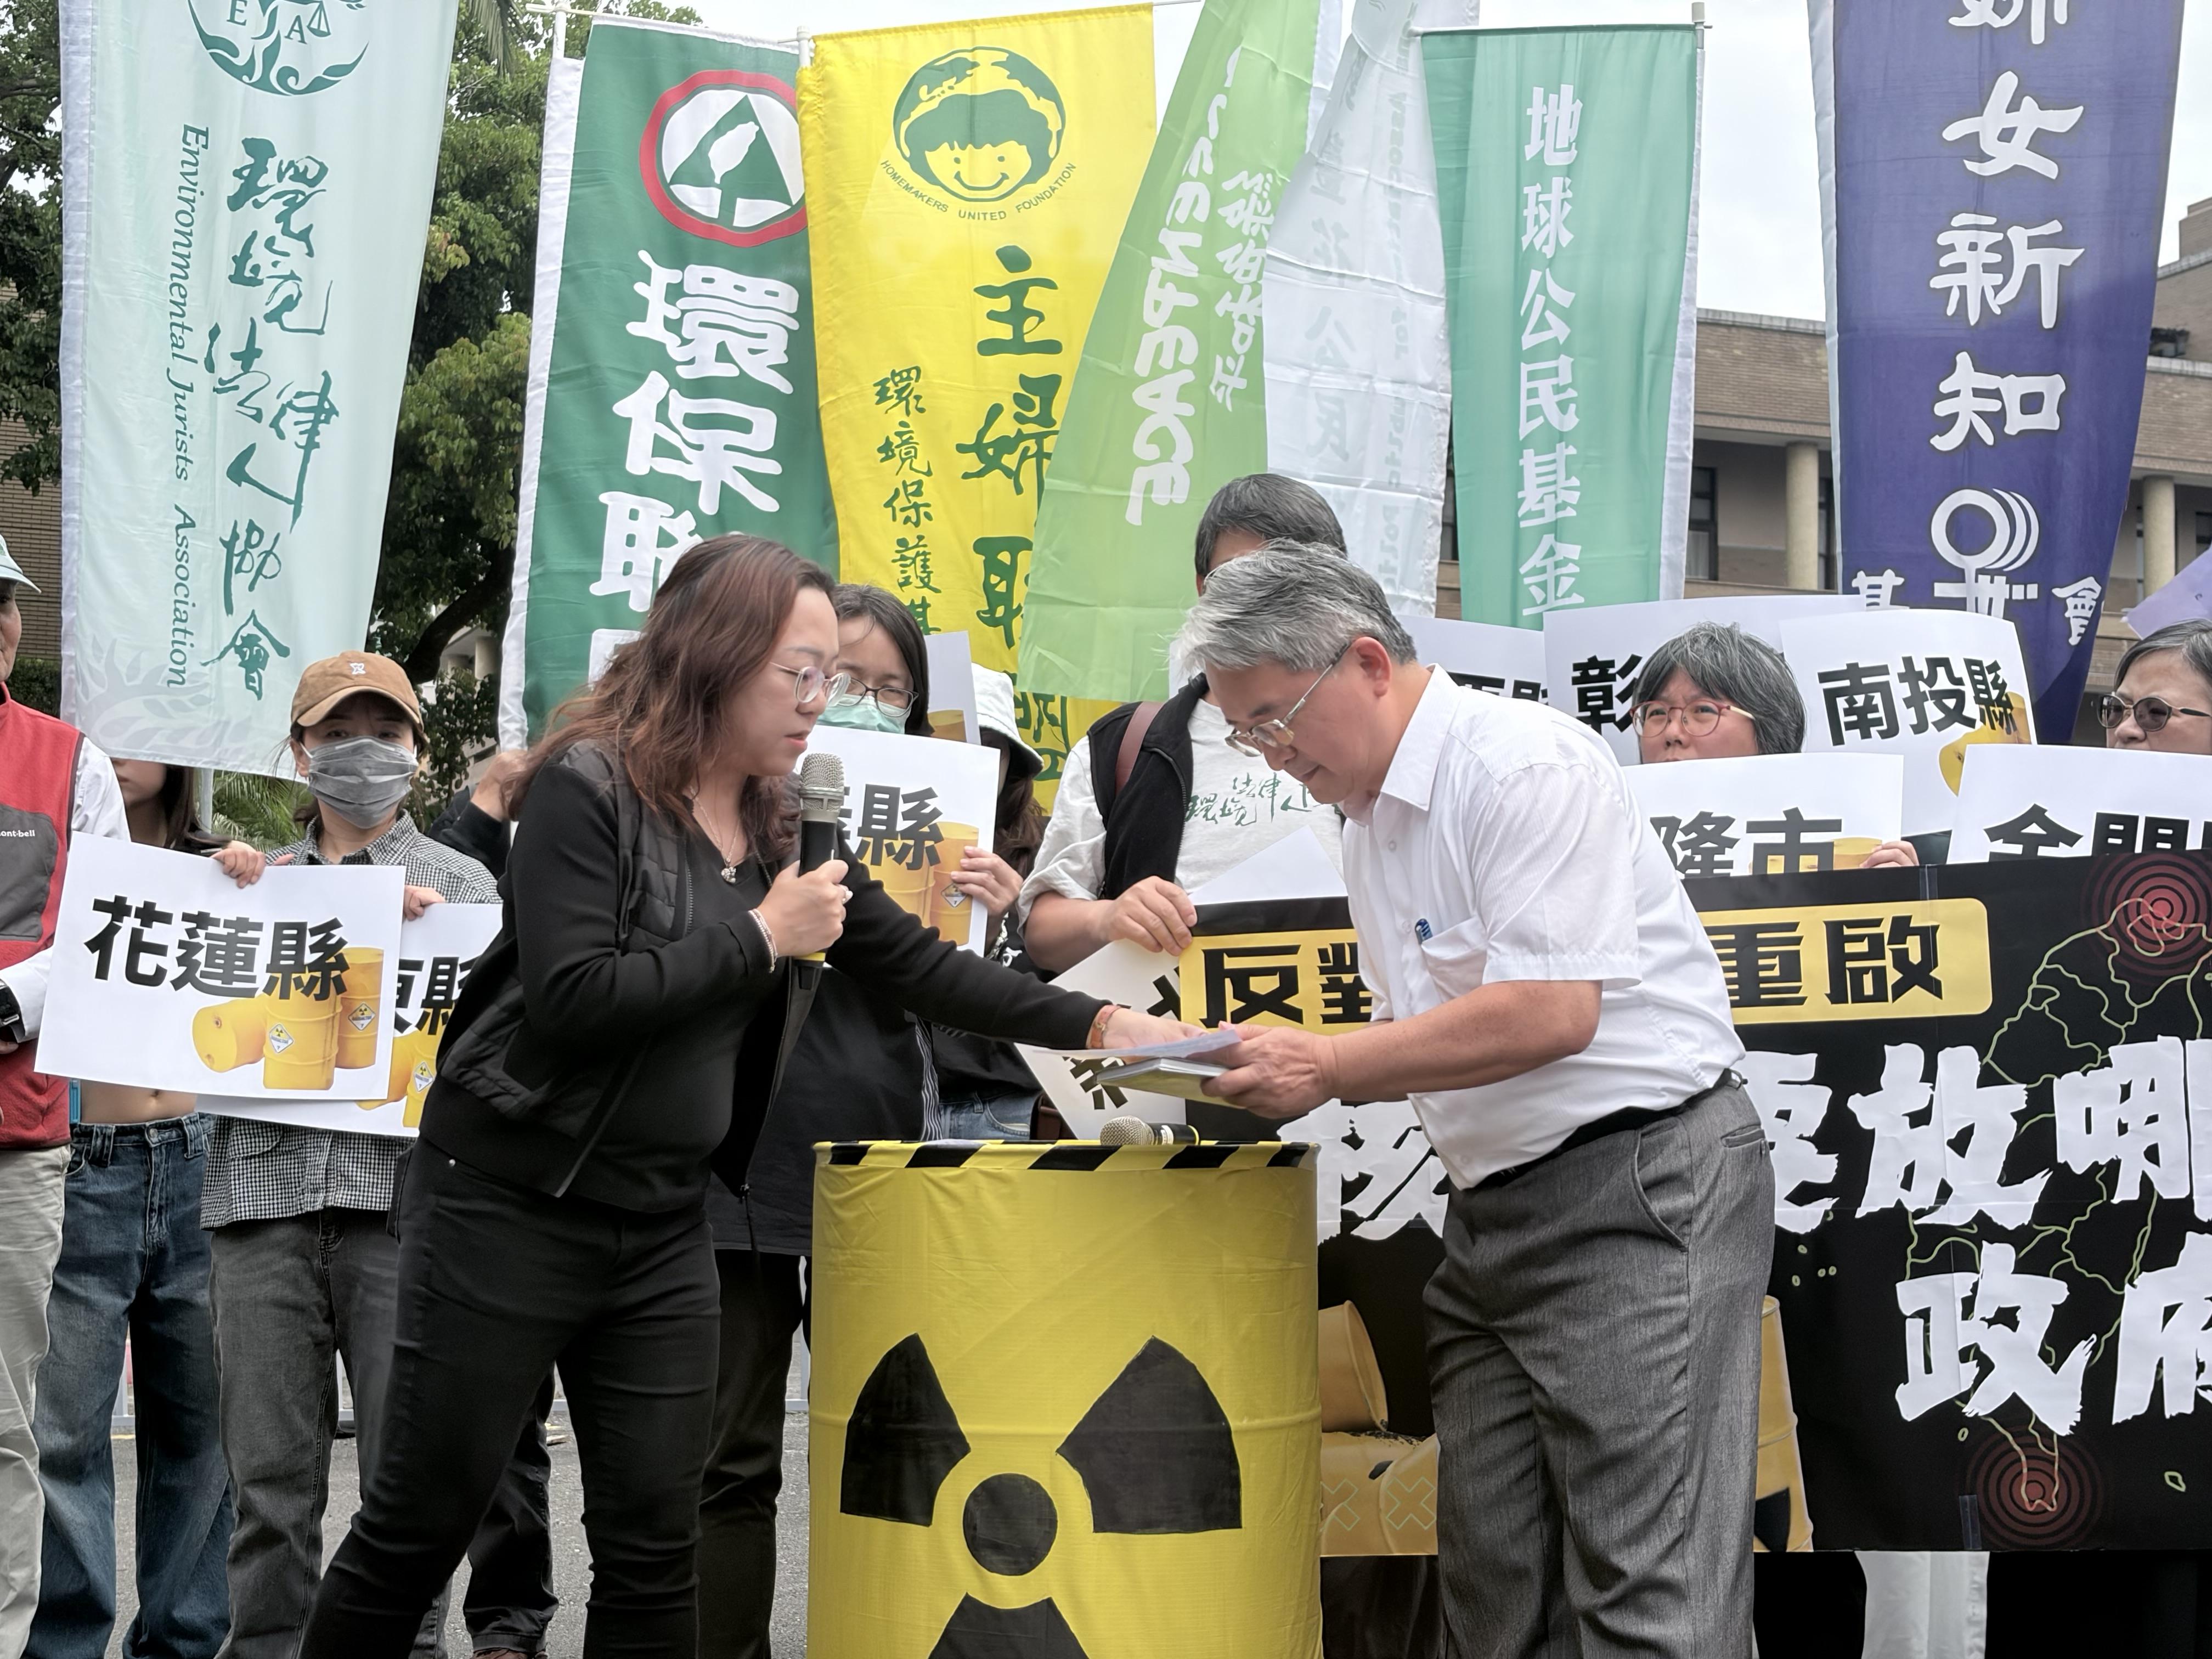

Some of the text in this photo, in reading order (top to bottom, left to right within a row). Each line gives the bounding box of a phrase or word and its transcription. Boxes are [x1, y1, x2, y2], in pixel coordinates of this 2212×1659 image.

[284, 15, 307, 44] A
[880, 160, 1076, 221] HOMEMAKERS UNITED FOUNDATION
[1517, 84, 1584, 616] 地球公民基金
[166, 124, 209, 688] Environmental Jurists Association
[589, 250, 800, 689] 環保聯
[1818, 656, 2017, 746] 南投縣
[837, 783, 945, 871] 縣
[1983, 803, 2212, 863] 金門
[84, 895, 351, 1001] 花蓮縣
